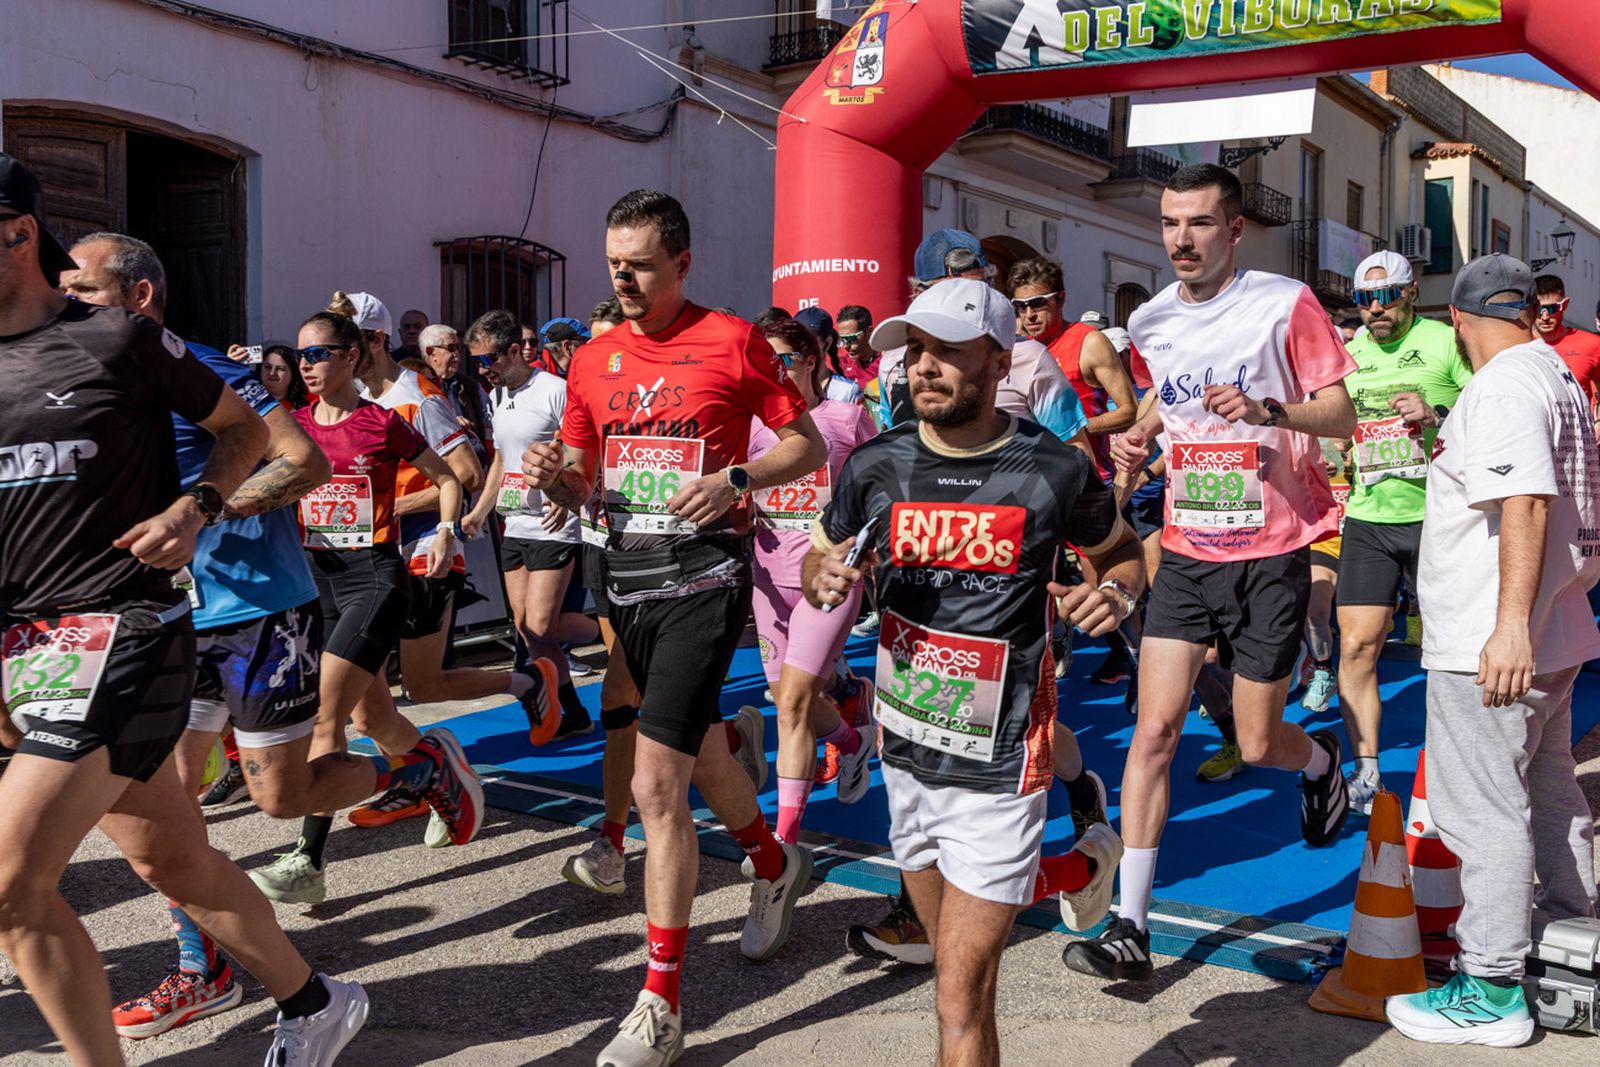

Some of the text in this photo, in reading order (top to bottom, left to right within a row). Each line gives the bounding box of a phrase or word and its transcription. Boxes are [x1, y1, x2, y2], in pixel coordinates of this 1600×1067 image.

[1061, 2, 1154, 53] DEL
[772, 258, 880, 283] YUNTAMIENTO
[799, 297, 820, 312] DE
[1176, 364, 1251, 405] Sald
[608, 385, 686, 411] CROSS
[1359, 424, 1370, 436] X
[617, 441, 684, 463] X CROSS
[1180, 447, 1244, 463] X CROSS
[1365, 437, 1411, 464] 760
[617, 460, 670, 472] PANTANO
[1182, 463, 1232, 472] PANTANO
[316, 483, 358, 494] CROSS
[618, 469, 680, 504] 496
[766, 487, 817, 512] 422
[1185, 471, 1243, 502] 699
[310, 500, 358, 526] 573
[897, 508, 996, 542] ENTRE
[894, 535, 1016, 568] OLIVOS
[893, 621, 981, 669] X CROSS
[891, 643, 962, 680] PANTANO
[888, 660, 976, 719] 527
